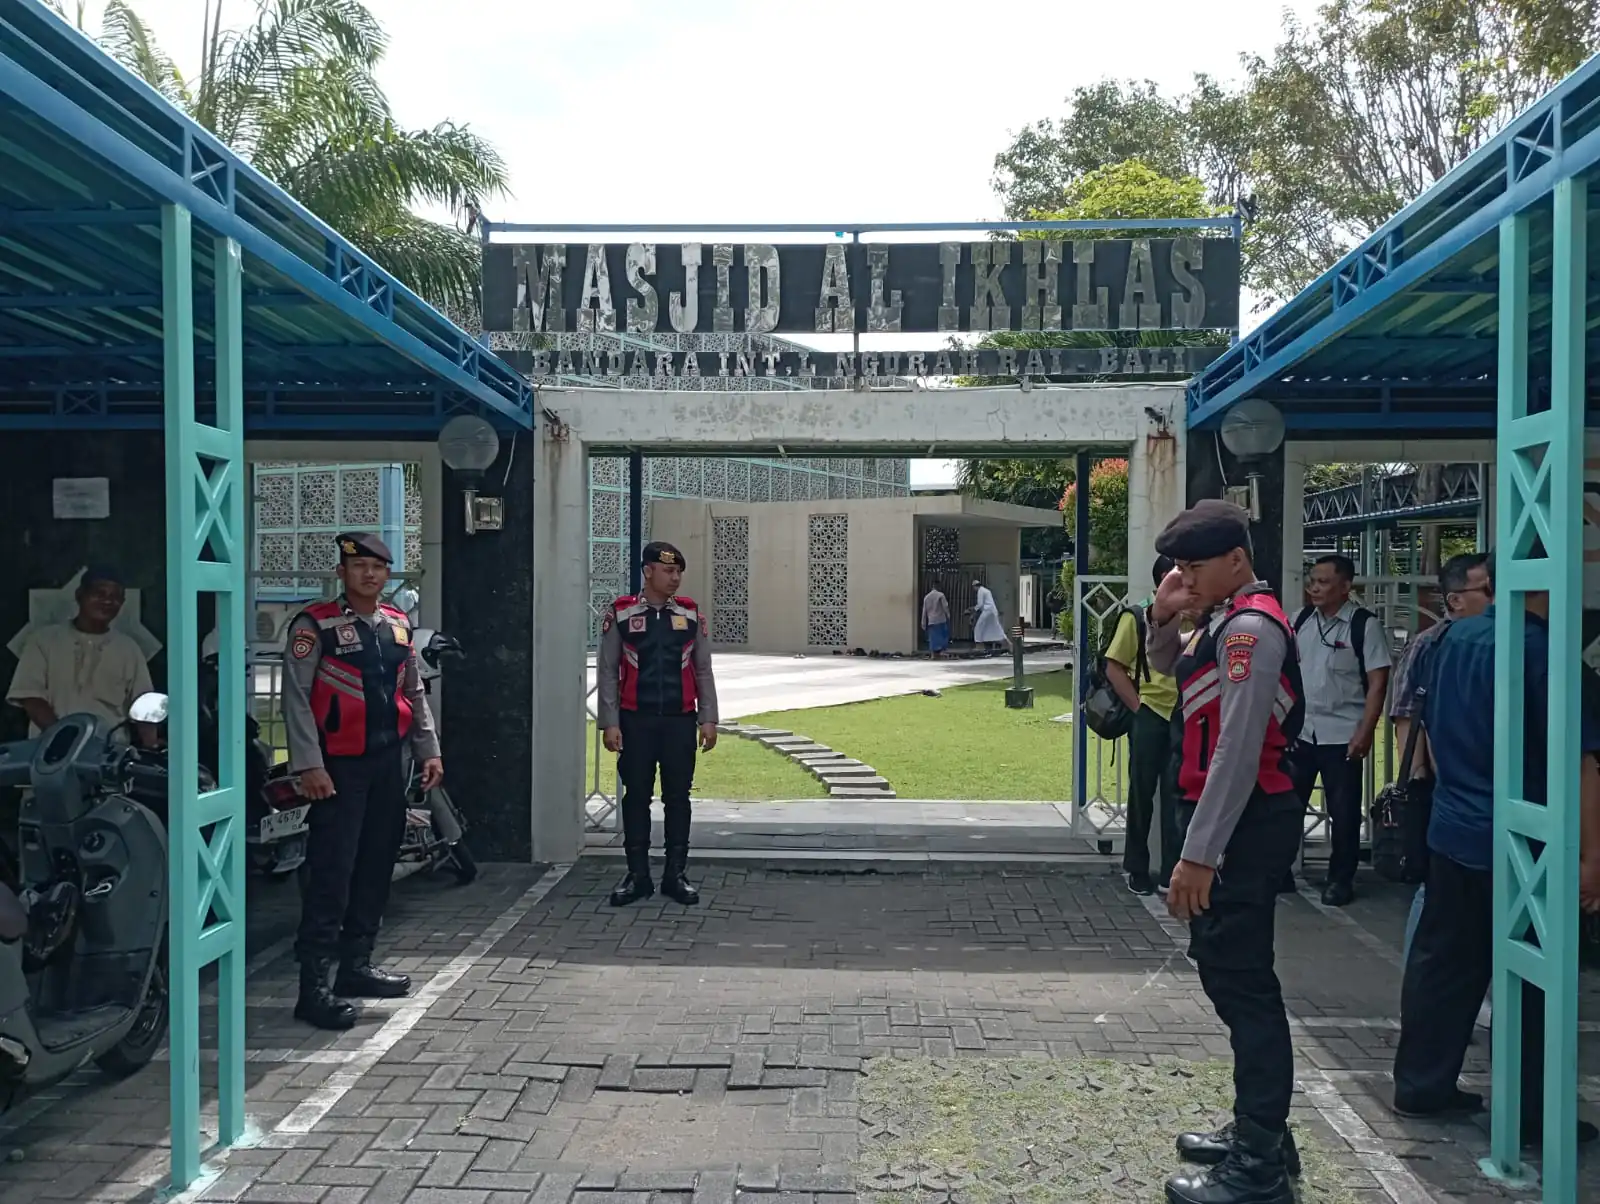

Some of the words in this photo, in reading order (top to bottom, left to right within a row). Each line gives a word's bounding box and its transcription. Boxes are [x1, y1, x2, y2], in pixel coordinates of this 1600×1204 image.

[512, 242, 781, 333] MASJID
[814, 243, 903, 333] AL
[937, 236, 1206, 332] IKHLAS
[531, 350, 701, 376] BANDARA
[834, 350, 980, 377] NGURAH
[997, 347, 1062, 376] RAI
[1099, 347, 1186, 375] BALI
